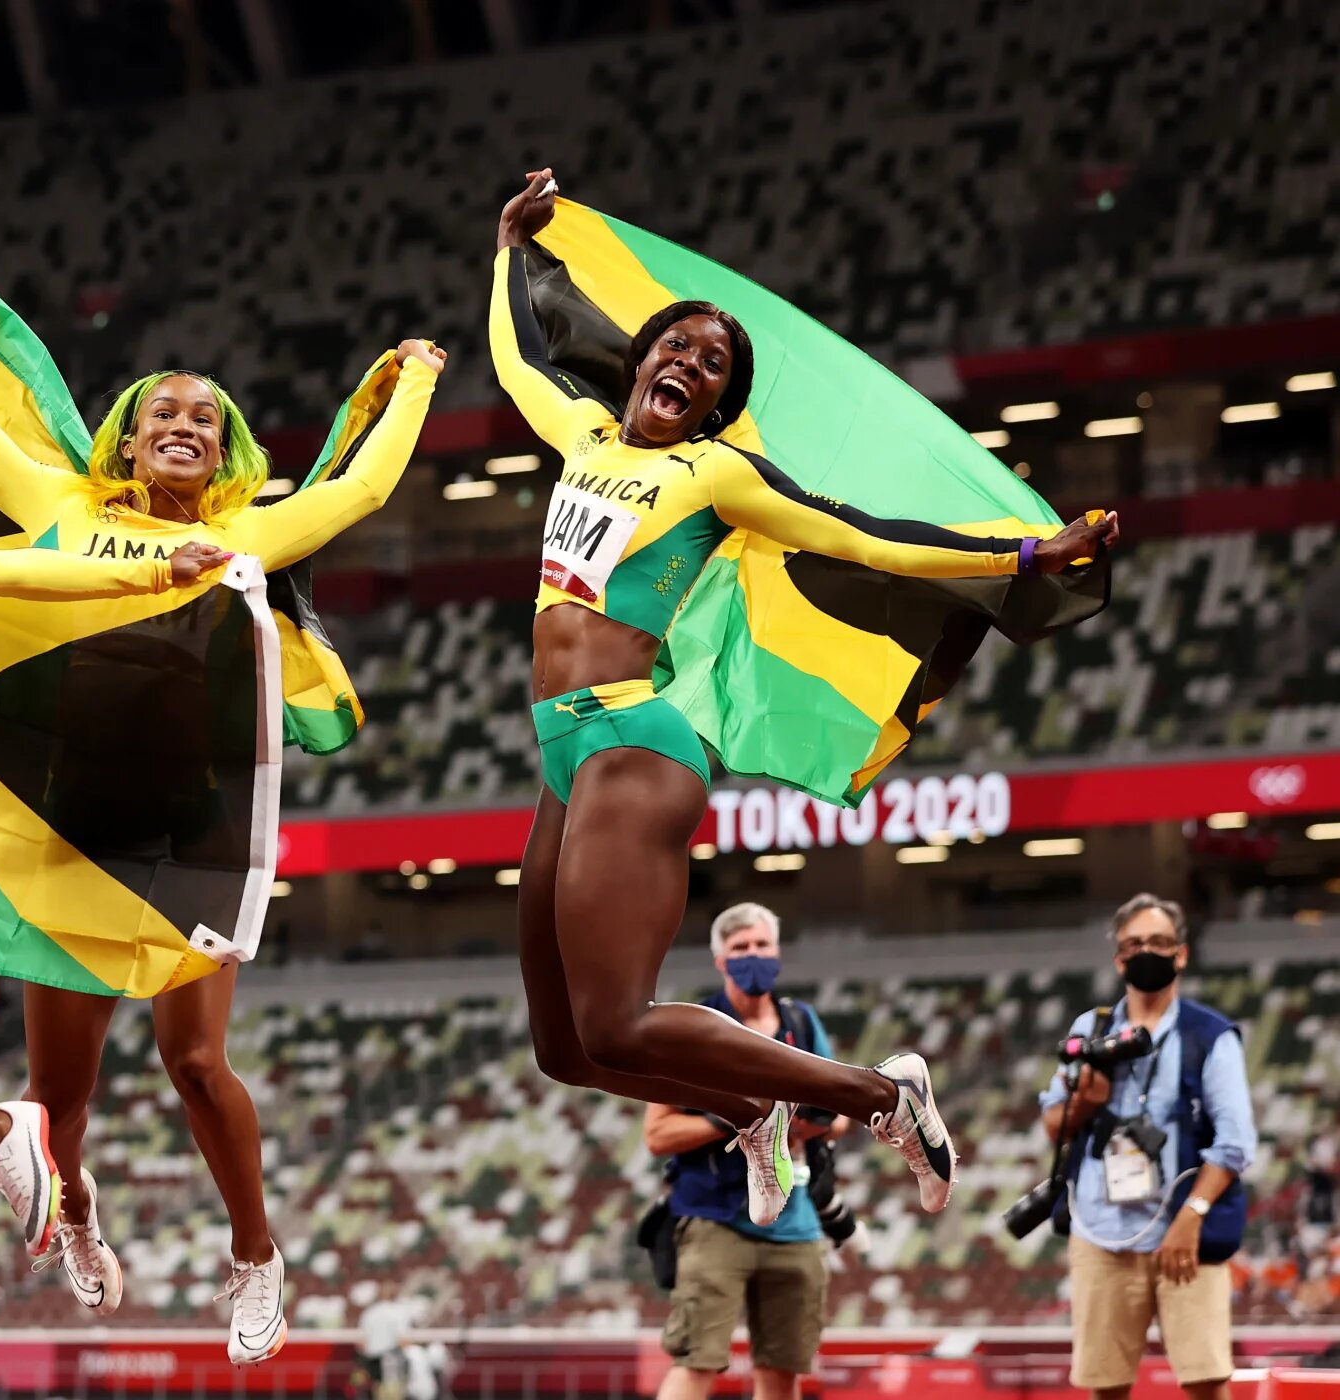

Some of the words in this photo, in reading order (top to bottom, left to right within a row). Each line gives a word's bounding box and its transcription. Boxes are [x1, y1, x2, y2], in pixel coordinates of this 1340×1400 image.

[82, 533, 180, 561] JAMA
[543, 499, 614, 562] JAM
[709, 785, 878, 853] TOKYO
[881, 771, 1012, 844] 2020
